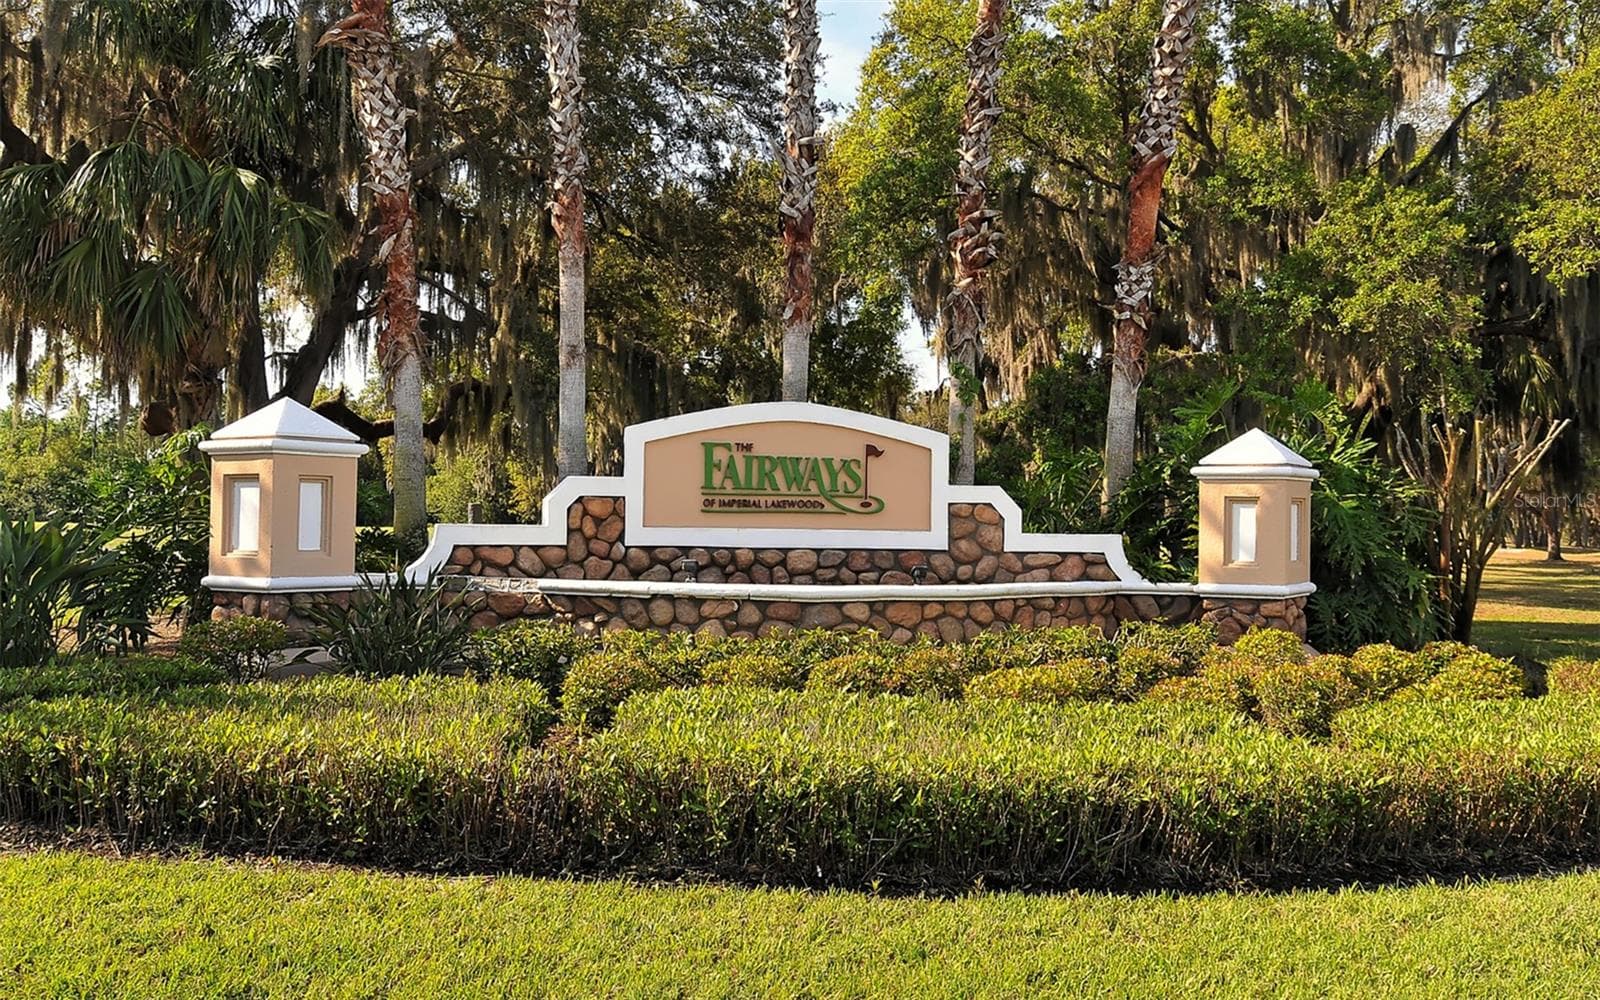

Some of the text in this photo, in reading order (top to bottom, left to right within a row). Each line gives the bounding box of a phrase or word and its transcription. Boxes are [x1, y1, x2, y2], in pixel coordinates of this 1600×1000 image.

[735, 442, 754, 452] THE
[701, 442, 862, 494] FAIRWAYS
[703, 498, 716, 508] OF
[719, 498, 763, 508] IMPERIAL
